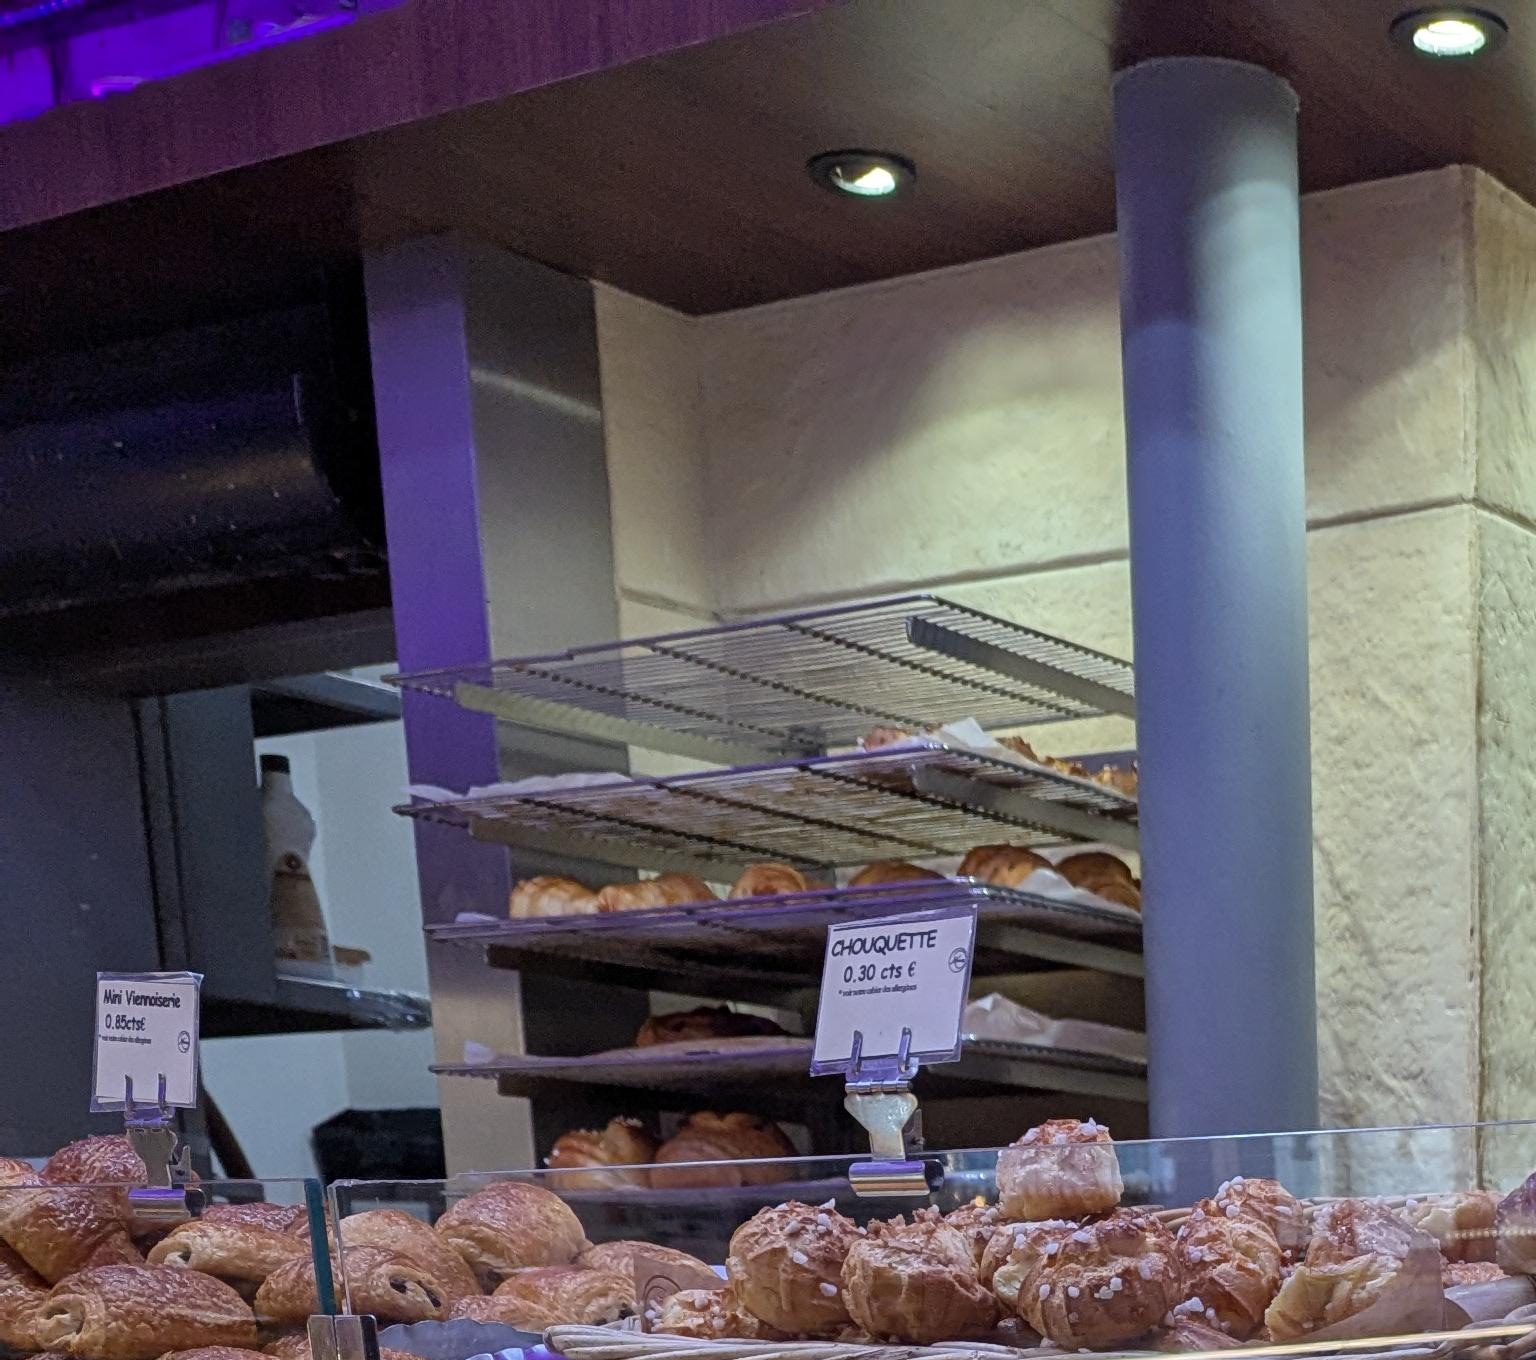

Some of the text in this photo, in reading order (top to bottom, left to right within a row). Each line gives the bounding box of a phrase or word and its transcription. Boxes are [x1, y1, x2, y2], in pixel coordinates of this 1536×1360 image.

[831, 929, 938, 957] CHOUQUETTE
[843, 961, 917, 983] 0.30 cts €
[103, 989, 181, 1008] Mini Viennoiserie
